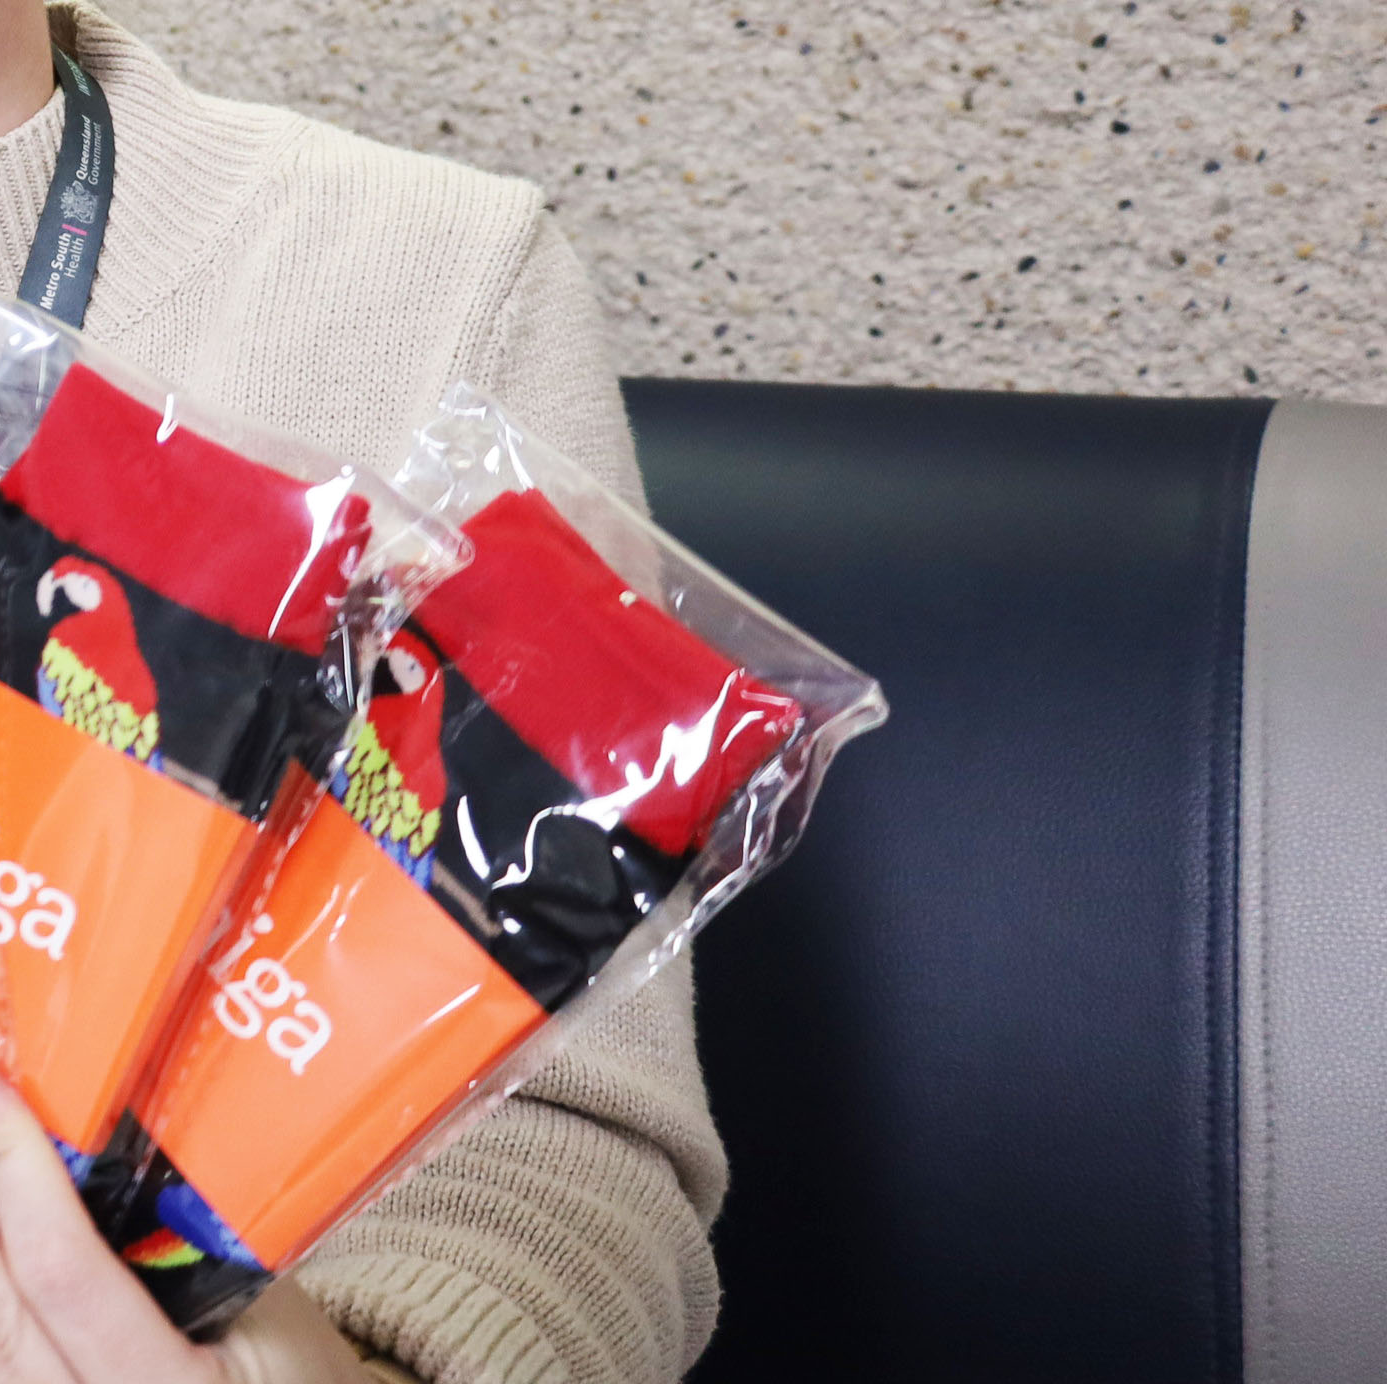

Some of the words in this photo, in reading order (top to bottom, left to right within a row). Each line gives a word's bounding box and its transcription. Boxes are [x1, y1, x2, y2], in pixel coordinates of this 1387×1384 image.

[75, 115, 91, 181] Queensland
[87, 123, 102, 186] Government
[39, 272, 61, 311] Metro
[51, 231, 73, 272] South
[64, 237, 86, 280] Health
